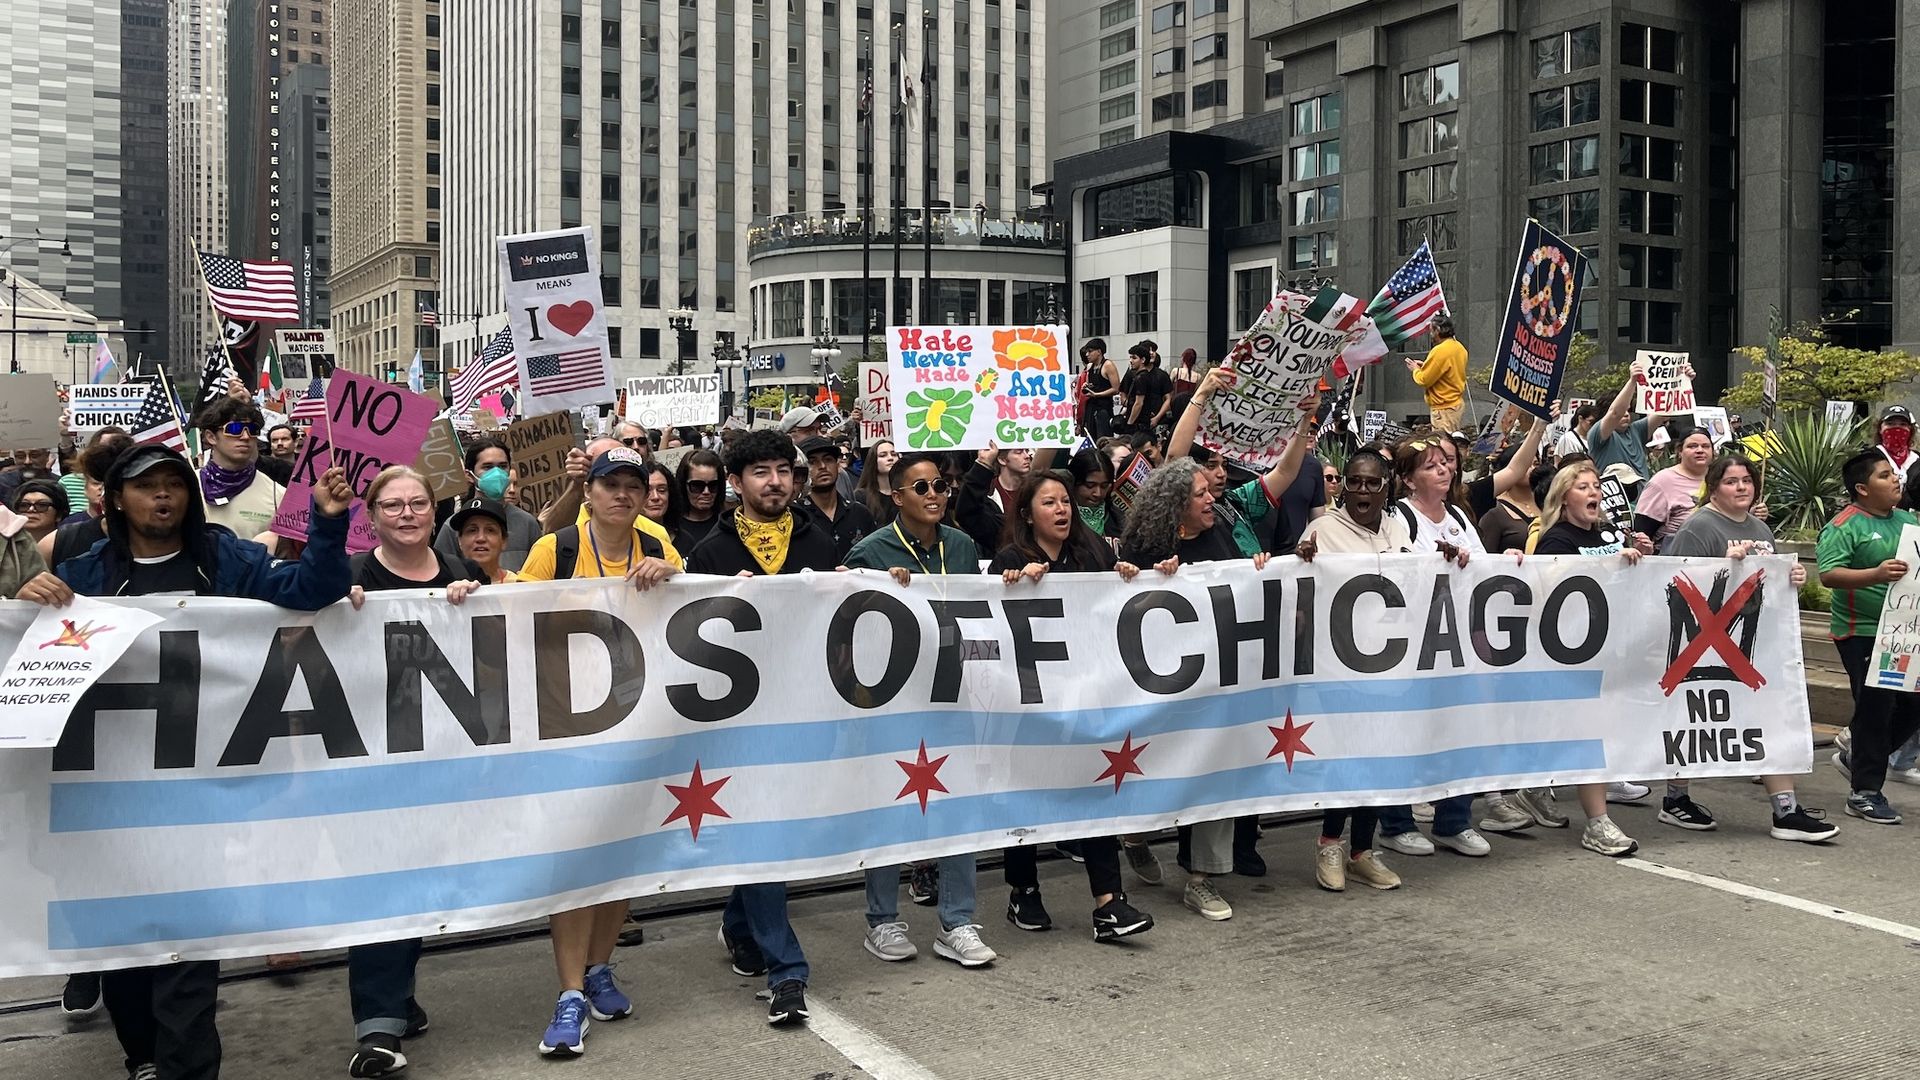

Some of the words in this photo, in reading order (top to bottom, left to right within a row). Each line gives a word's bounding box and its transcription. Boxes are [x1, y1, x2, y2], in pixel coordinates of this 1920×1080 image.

[270, 77, 279, 114] THE
[270, 127, 280, 262] STEAKHOUSE
[303, 245, 311, 260] L7
[535, 254, 550, 264] NO
[550, 251, 579, 262] KINGS
[303, 263, 312, 306] HOTELS
[536, 278, 572, 291] MEANS
[524, 306, 544, 342] I
[898, 328, 973, 351] Hate
[1283, 312, 1320, 349] YOU
[288, 344, 325, 353] WATCHES
[1253, 333, 1290, 365] ON
[1514, 321, 1529, 347] NO
[1528, 335, 1558, 361] KINGS
[901, 351, 972, 368] Never
[1237, 353, 1279, 384] BUT
[1507, 354, 1519, 373] NO
[1519, 363, 1551, 388] TYRANTS
[1511, 340, 1522, 358] NO
[1521, 349, 1554, 375] FASCISTS
[628, 376, 719, 396] IMMIGRANTS
[915, 367, 970, 383] Made
[1007, 371, 1066, 402] Any
[1503, 368, 1520, 394] NO
[1518, 381, 1548, 408] HATE
[75, 387, 117, 398] HANDS
[121, 387, 144, 398] OFF
[332, 380, 403, 436] NO
[817, 401, 831, 413] OFF
[994, 395, 1074, 420] Nation
[1212, 388, 1266, 419] PREY
[1260, 410, 1292, 425] ALL
[1246, 383, 1286, 407] ICE
[1673, 389, 1694, 411] HAT
[75, 413, 137, 426] CHICAG
[509, 411, 573, 452] DEMOCRACY
[995, 419, 1076, 445] Great
[1217, 413, 1280, 444] WEEK?
[292, 435, 393, 500] KING
[518, 454, 551, 478] DIES
[17, 661, 42, 671] NO
[42, 661, 93, 671] KINGS.
[52, 596, 762, 771] HANDS
[826, 589, 1070, 709] OFF
[1116, 573, 1610, 695] CHICAGO
[2, 677, 27, 688] NO
[28, 677, 86, 687] TRUMP
[1686, 688, 1731, 724] NO
[1662, 728, 1766, 767] KINGS
